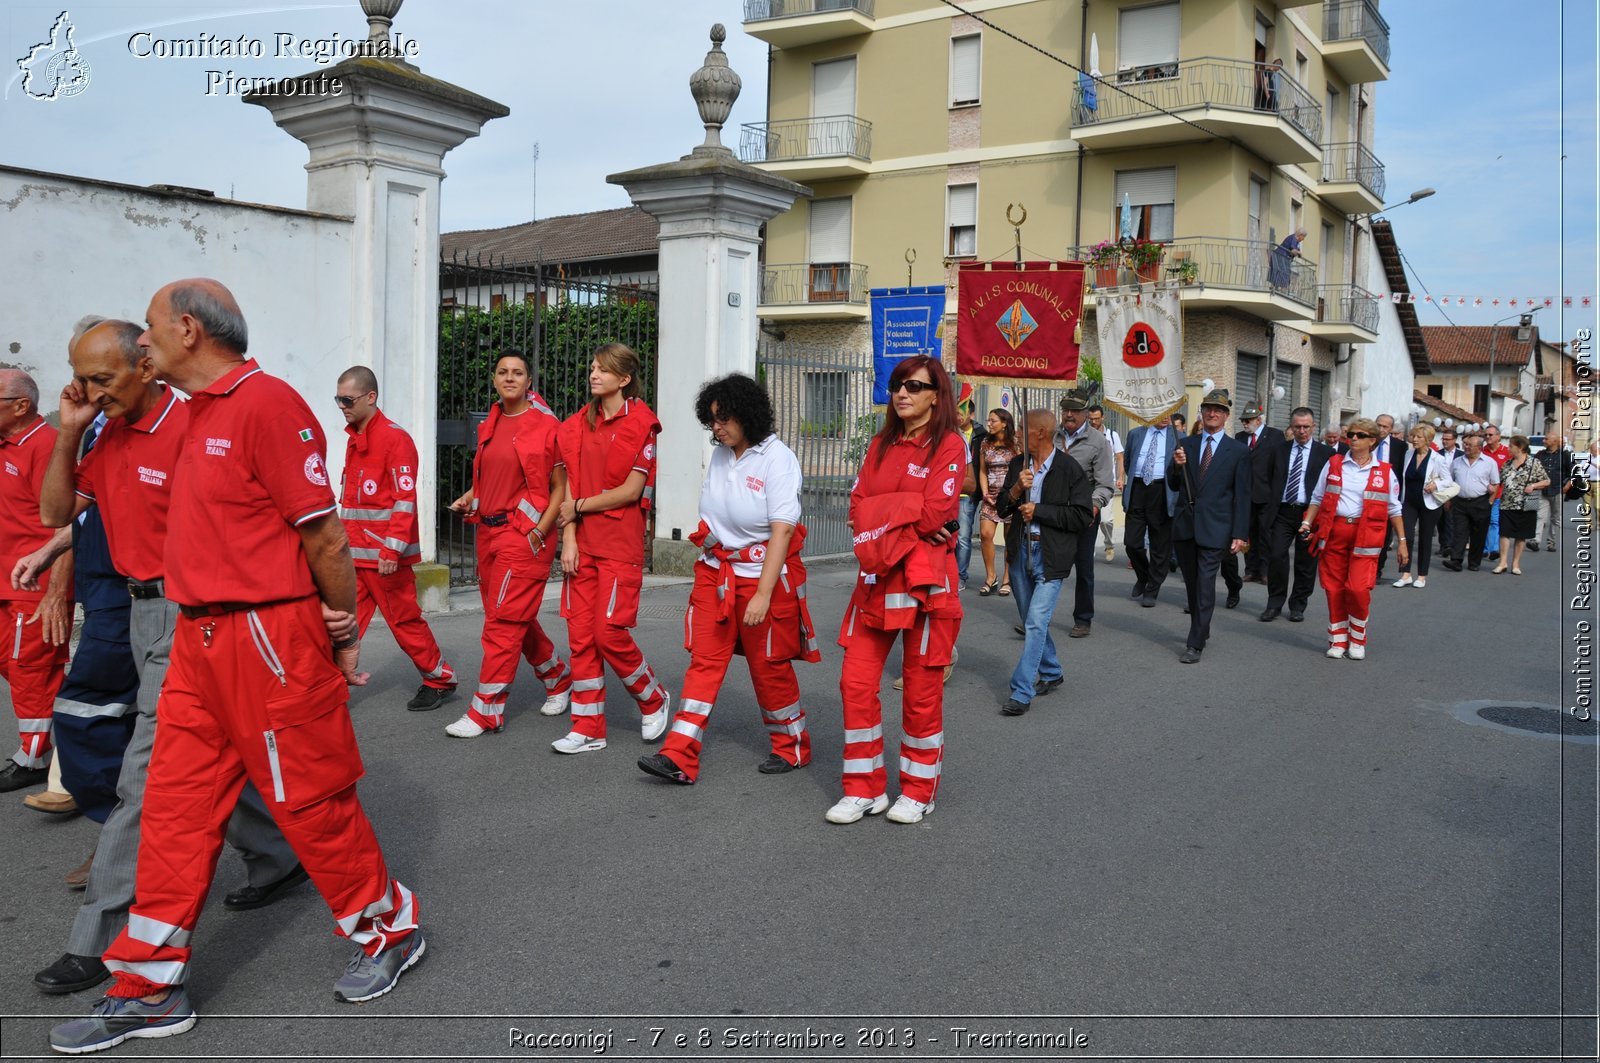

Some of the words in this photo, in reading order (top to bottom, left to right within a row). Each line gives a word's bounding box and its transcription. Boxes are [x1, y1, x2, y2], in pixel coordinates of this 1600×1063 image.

[1006, 281, 1074, 322] COMUNALE
[981, 355, 1049, 370] RACCONIGI
[1125, 377, 1157, 387] GRUPPO
[1158, 376, 1168, 386] DI
[1115, 386, 1179, 406] RACCONIGI
